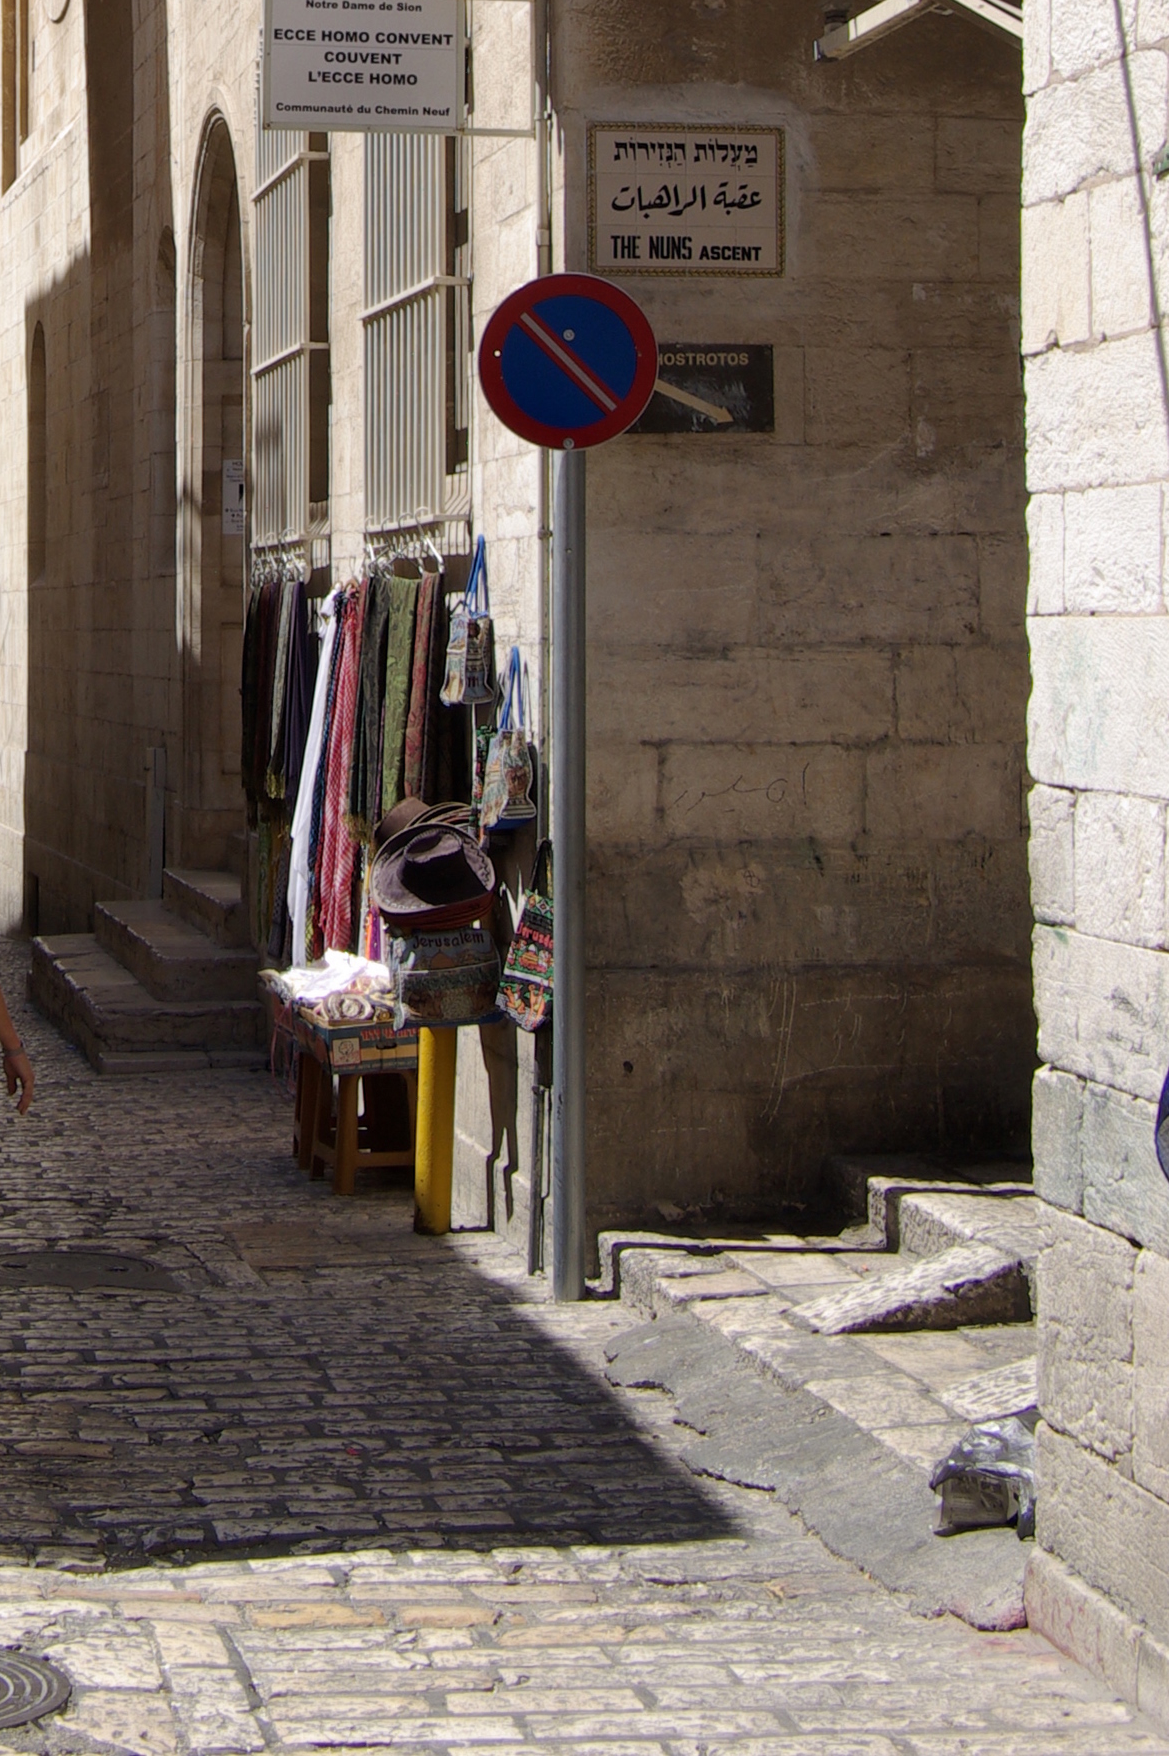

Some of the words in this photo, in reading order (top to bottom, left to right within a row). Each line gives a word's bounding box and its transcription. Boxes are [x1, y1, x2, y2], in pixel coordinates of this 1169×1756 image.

[305, 0, 339, 10] Notre
[342, 0, 375, 11] Dame
[378, 1, 394, 12] de
[396, 1, 423, 13] Sion
[273, 28, 316, 41] ECCE
[321, 30, 370, 43] HOMO
[375, 32, 453, 46] CONVENT
[324, 51, 402, 65] COUVENT
[308, 71, 364, 84] L'ECCE
[369, 73, 418, 86] HOMO
[276, 102, 353, 114] Communauté
[357, 104, 372, 115] du
[375, 105, 419, 116] Chemin
[422, 106, 450, 117] Neuf
[611, 184, 707, 219] الراهبات
[713, 181, 762, 215] عقبة
[611, 235, 641, 260] THE
[649, 236, 692, 260] NUNS
[699, 246, 762, 261] ASCENT
[413, 932, 485, 949] Jerusalem
